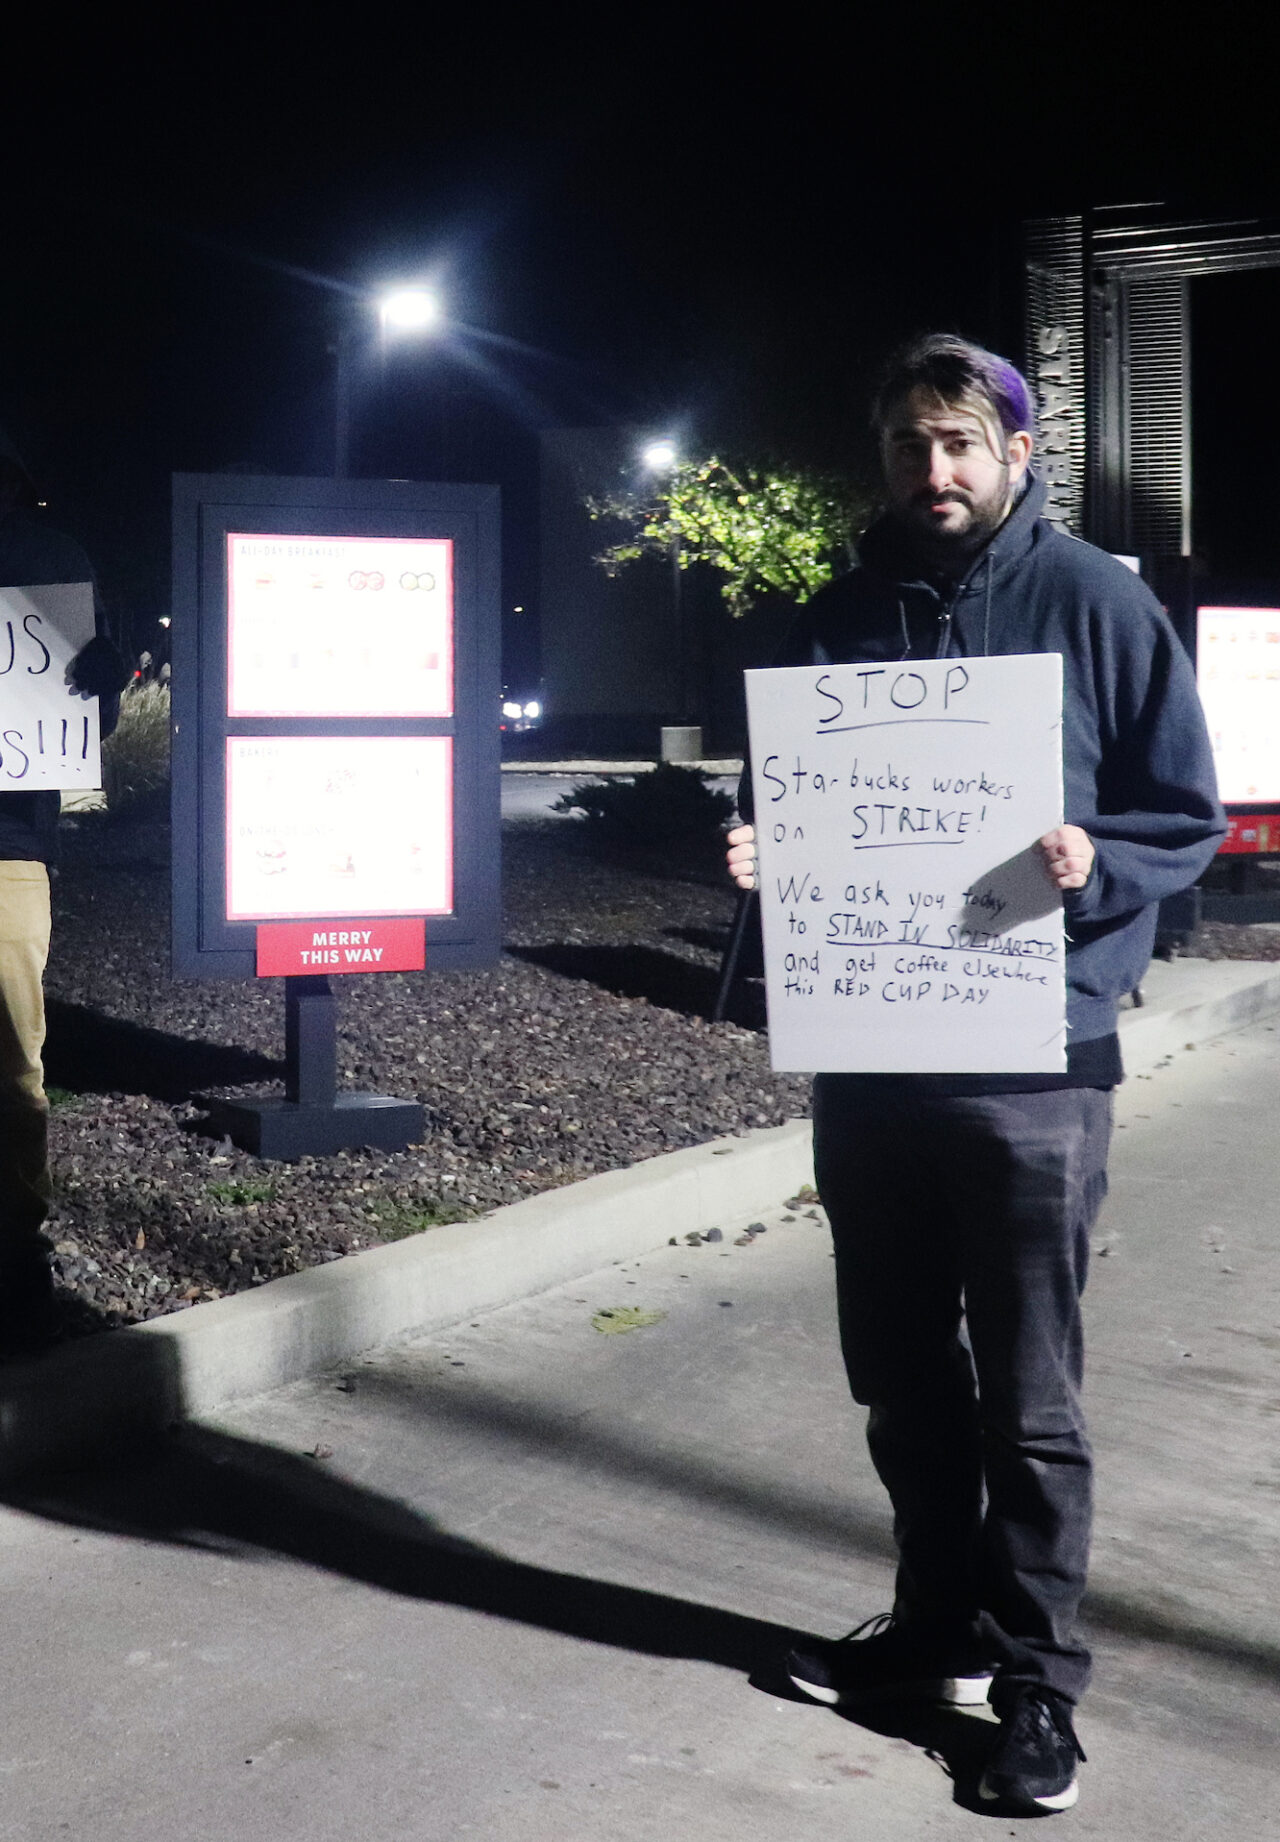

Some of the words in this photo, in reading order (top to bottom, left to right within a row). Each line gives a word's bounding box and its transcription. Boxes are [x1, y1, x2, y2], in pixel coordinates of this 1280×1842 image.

[815, 665, 969, 723] STOP
[933, 772, 1016, 799] workers
[773, 823, 804, 843] on
[851, 804, 986, 839] STRIKE!
[777, 873, 824, 904] We
[845, 880, 890, 906] ask
[909, 891, 945, 922] you
[312, 931, 372, 946] MERRY
[789, 911, 807, 935] to
[826, 913, 889, 938] STAND
[898, 920, 929, 945] IN
[947, 924, 1058, 957] SOLIDARITY
[300, 950, 340, 965] THIS
[344, 948, 383, 963] WAY
[784, 951, 819, 975] and
[846, 952, 876, 980] get
[894, 954, 949, 974] coffee
[963, 959, 1048, 986] elsewhere
[784, 977, 814, 997] this
[834, 979, 870, 996] RED
[882, 982, 931, 1002] CUP
[942, 983, 989, 1004] DAY
